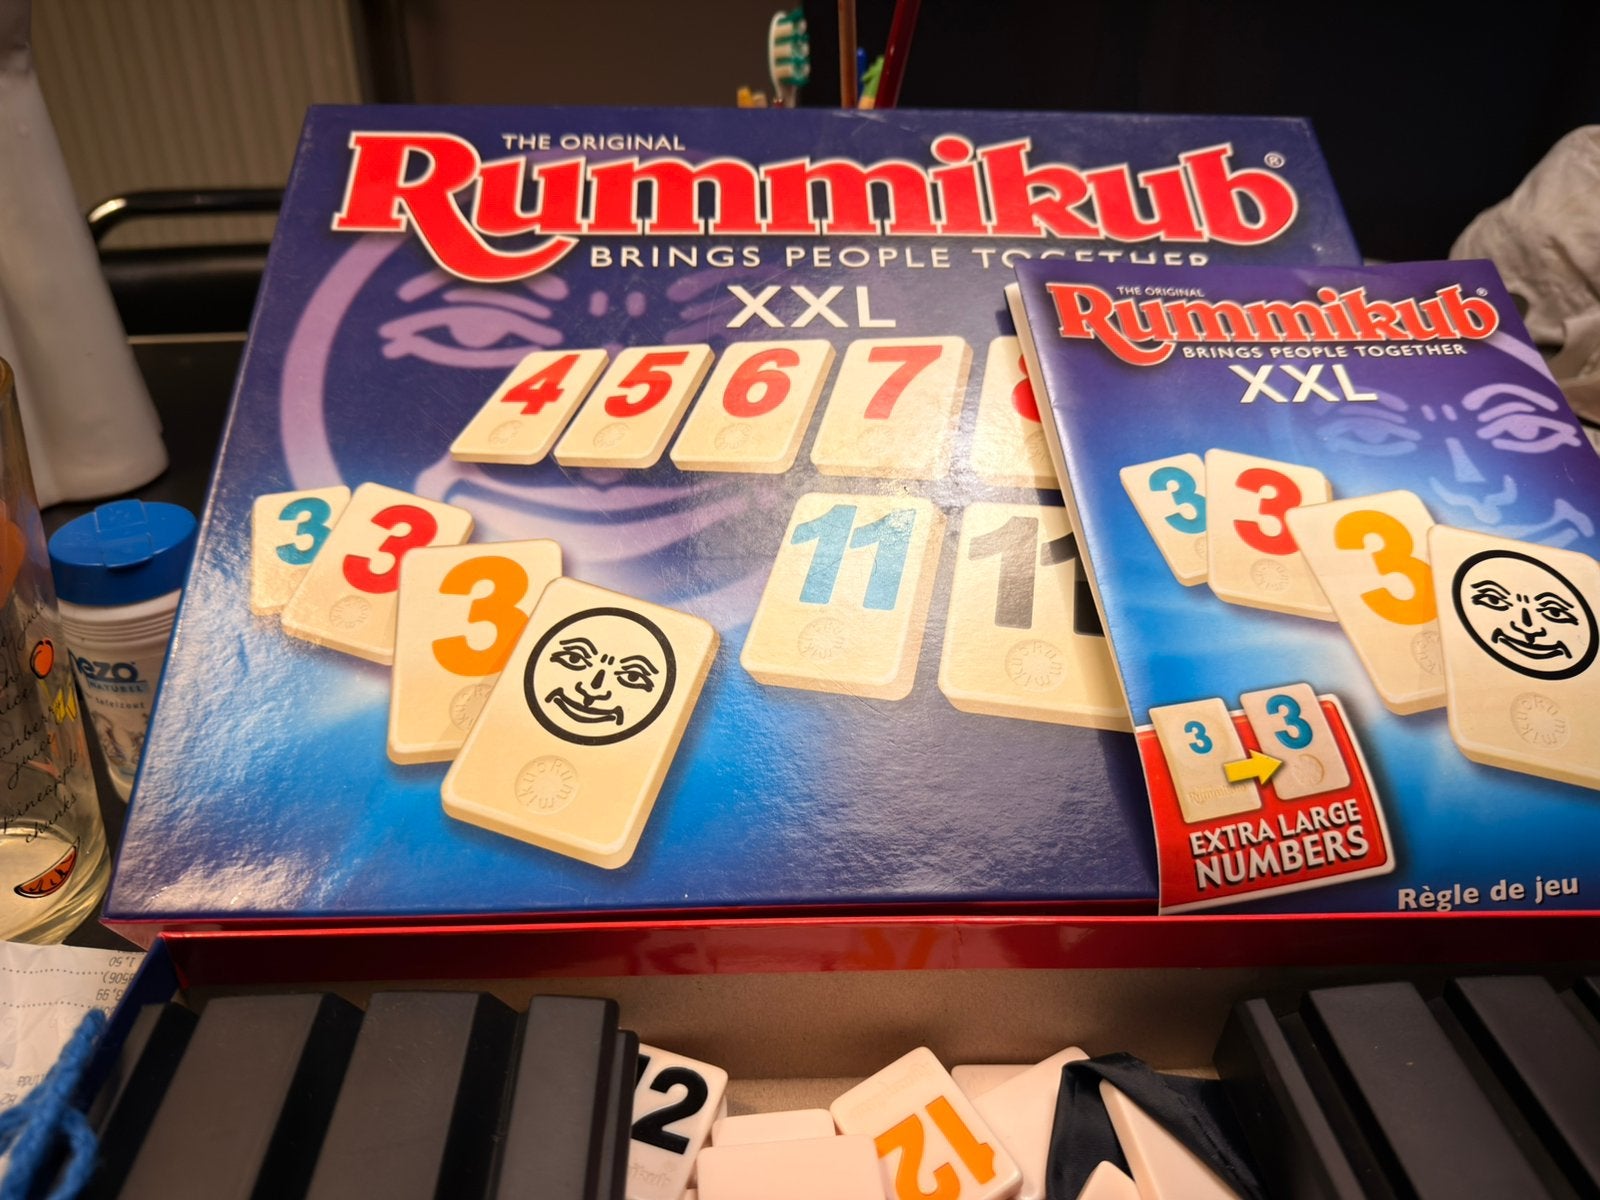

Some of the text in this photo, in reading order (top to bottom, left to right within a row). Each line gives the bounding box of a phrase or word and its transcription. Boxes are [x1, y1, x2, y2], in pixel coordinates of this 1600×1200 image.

[502, 134, 686, 151] THE ORIGINAL
[331, 130, 1299, 283] Rummikub
[590, 246, 761, 269] BRINGS
[785, 246, 951, 269] PEOPLE
[726, 285, 897, 328] XXL
[1116, 286, 1206, 298] THE ORIGINAL
[1045, 283, 1500, 367] Rummikub
[1182, 343, 1468, 359] BRINGS PEOPLE TOGETHER
[502, 354, 579, 415] 4
[604, 351, 689, 418] 5
[722, 348, 800, 417] 6
[863, 345, 943, 420] 7
[1228, 364, 1378, 404] XXL
[276, 497, 331, 565] 3
[1148, 466, 1206, 534] 3
[1233, 467, 1303, 556] 3
[342, 504, 438, 594] 3
[790, 503, 917, 611] 11
[1334, 509, 1438, 626] 3
[432, 555, 529, 677] 3
[1183, 720, 1214, 755] 3
[1265, 693, 1314, 751] 3
[1189, 798, 1362, 856] EXTRA LARGE
[1195, 825, 1370, 889] NUMBERS
[1398, 875, 1578, 912] Règle de jeu
